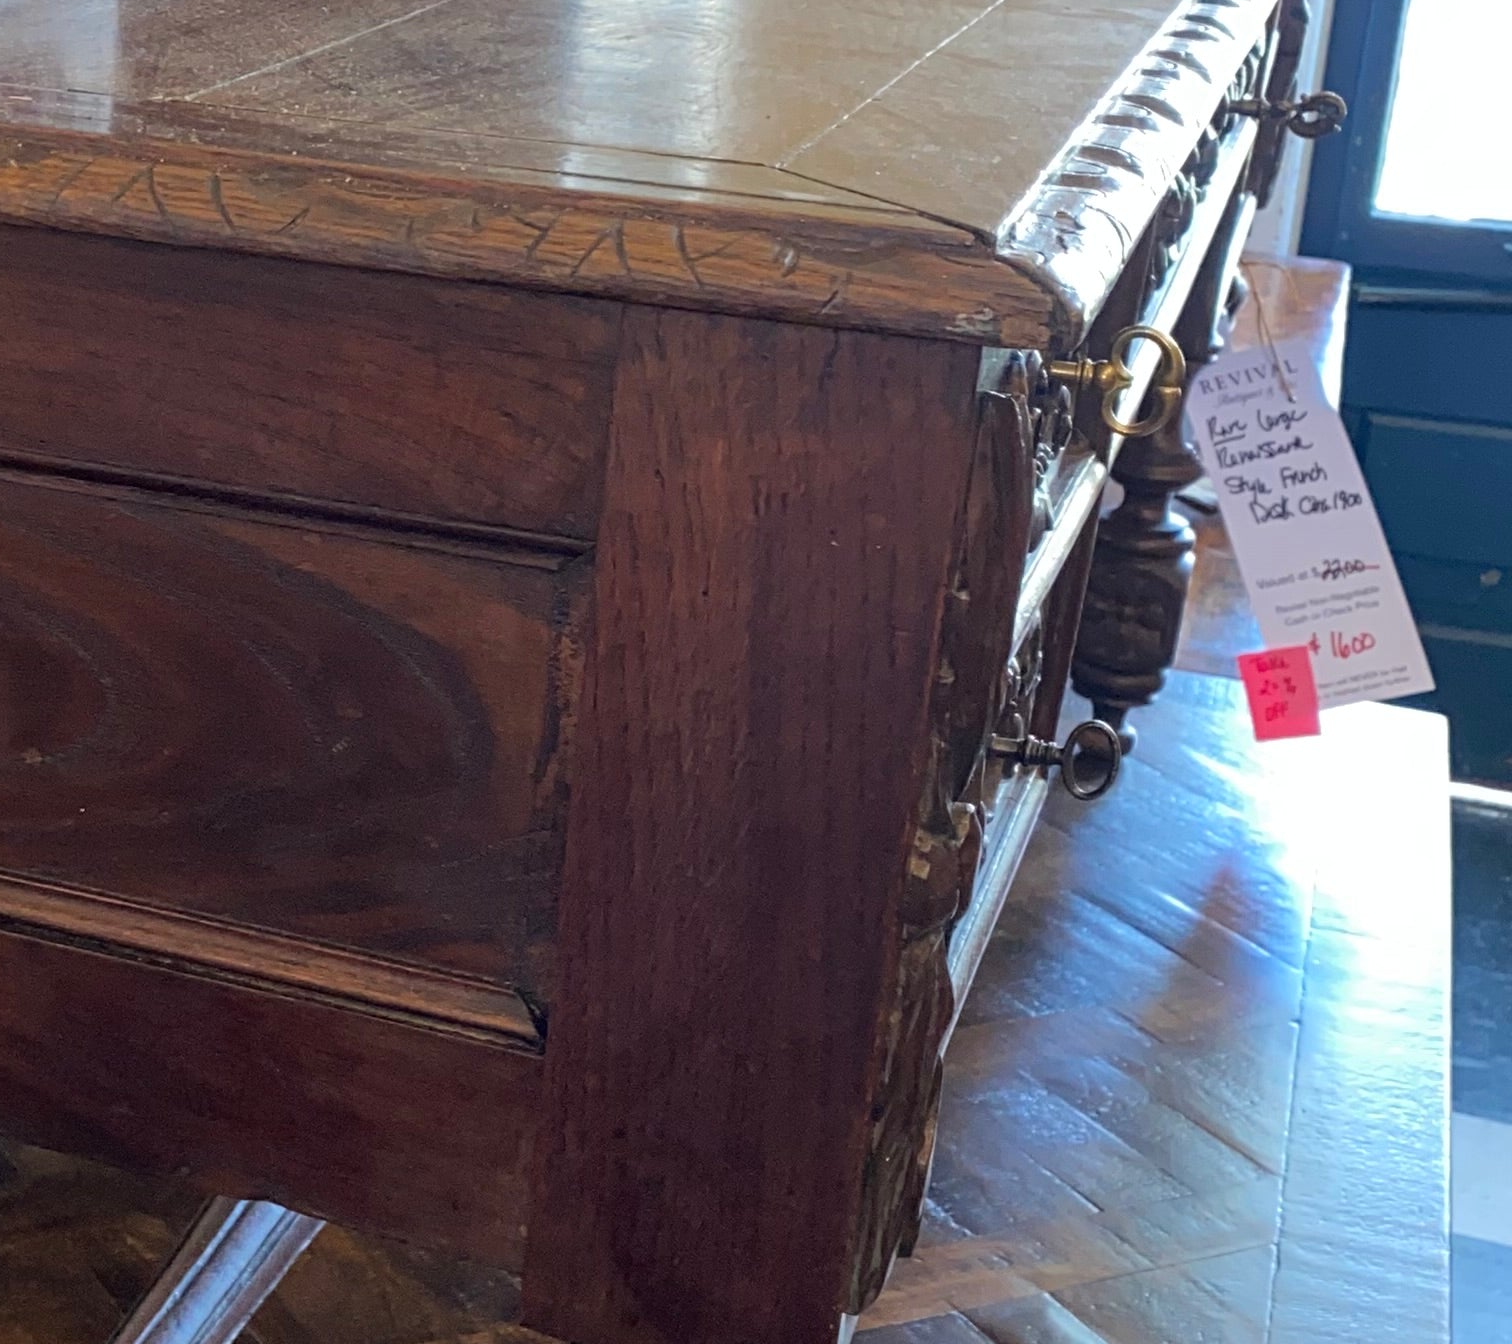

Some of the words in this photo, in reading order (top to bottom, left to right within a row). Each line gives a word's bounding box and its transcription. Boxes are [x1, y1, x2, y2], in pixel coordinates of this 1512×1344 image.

[1198, 359, 1299, 394] REVIVAL
[1224, 475, 1273, 504] Style
[1280, 461, 1328, 489] French
[1248, 494, 1295, 524] Desk
[1332, 489, 1363, 511] 1900
[1330, 630, 1376, 660] 1600
